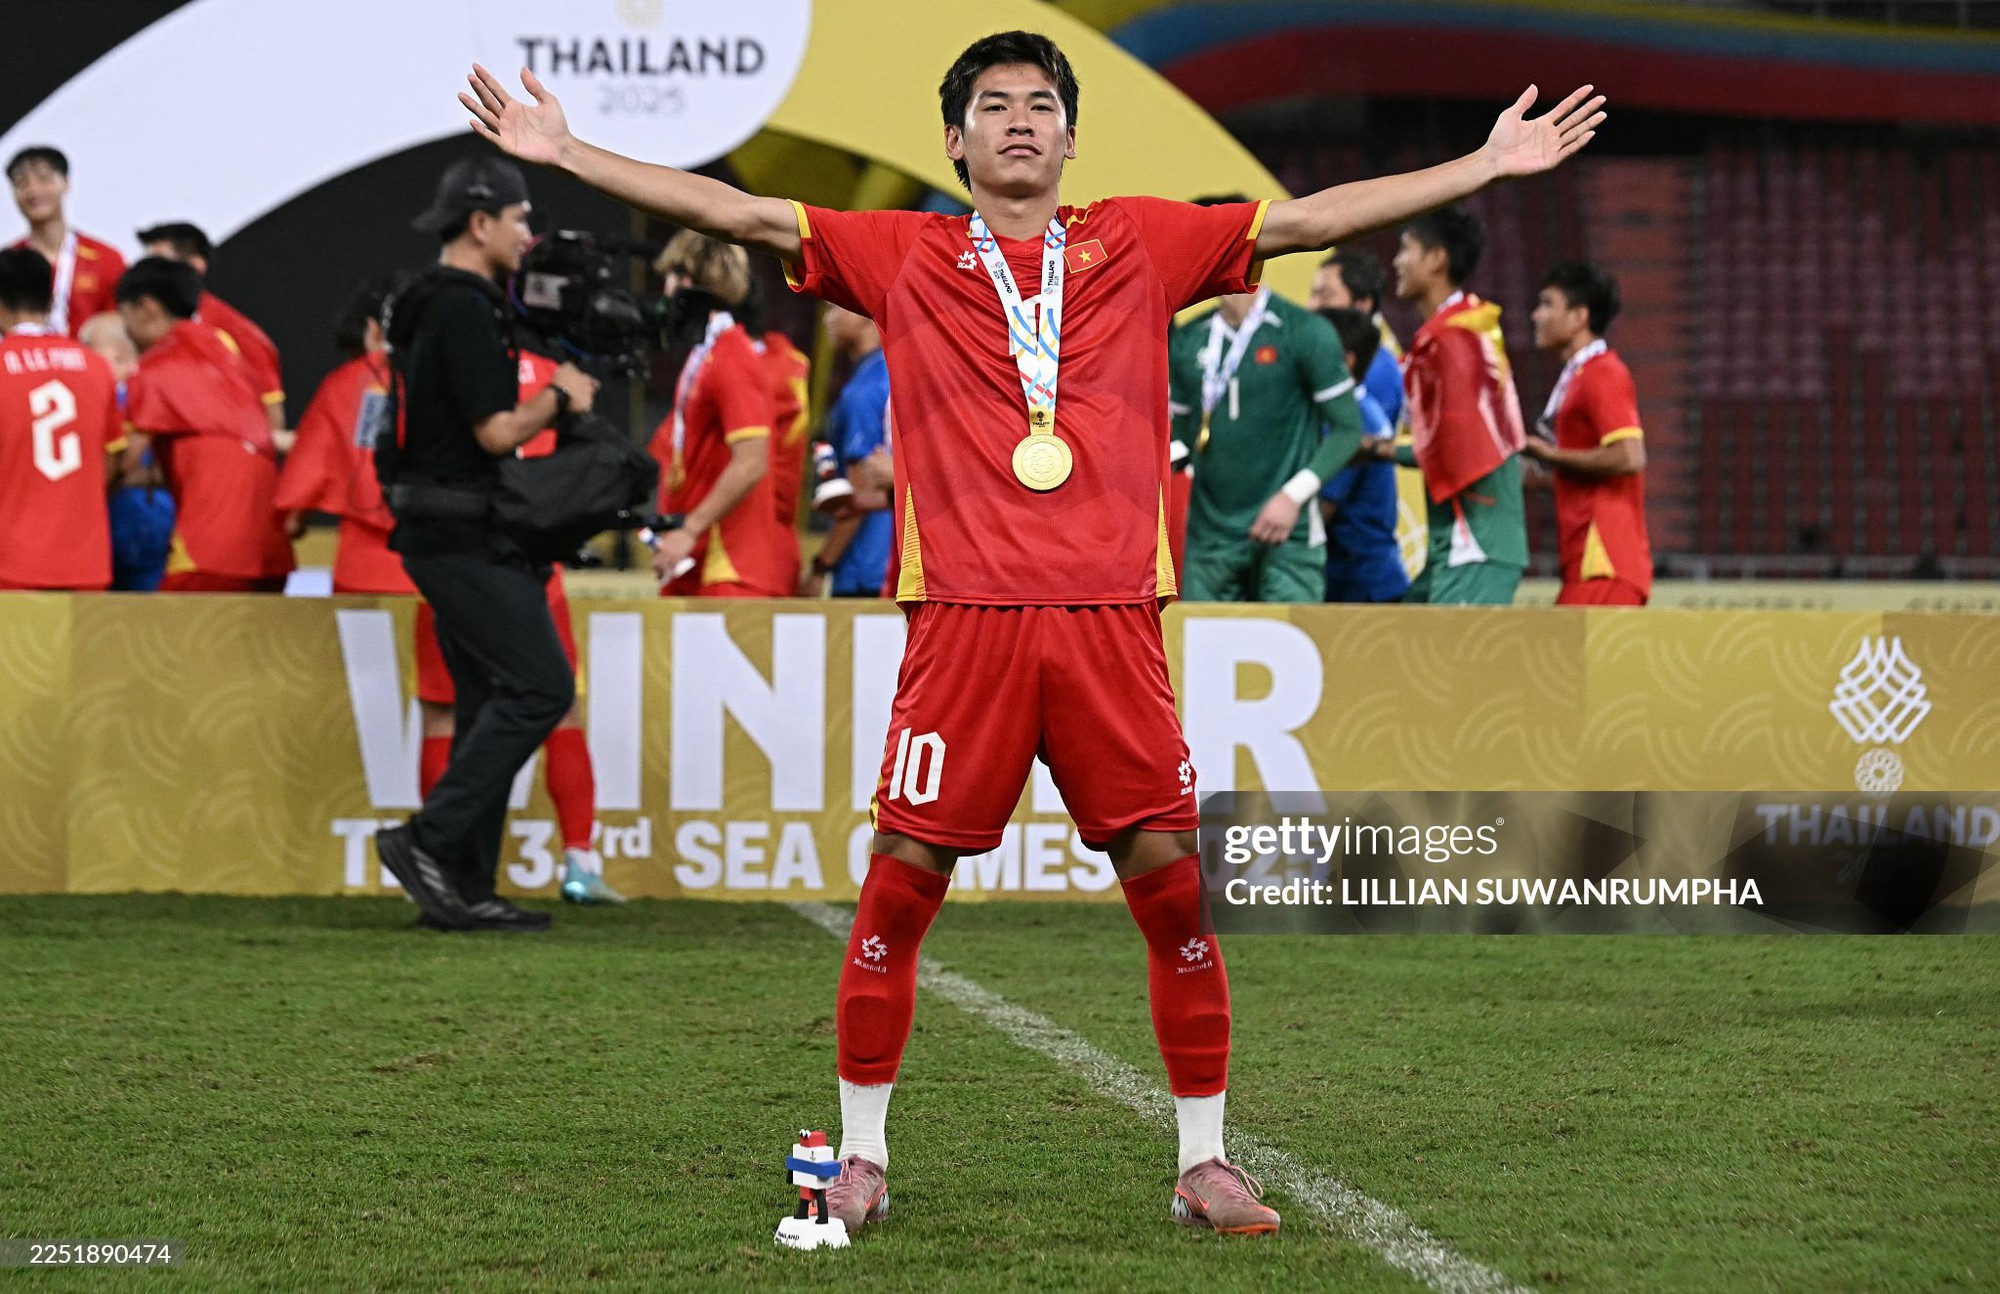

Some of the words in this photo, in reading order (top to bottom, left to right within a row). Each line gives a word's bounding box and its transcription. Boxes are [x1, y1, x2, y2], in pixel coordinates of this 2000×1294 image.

[515, 37, 766, 75] THAILAND
[598, 84, 686, 115] 2025
[29, 379, 82, 482] 2
[888, 727, 947, 806] 10
[1754, 803, 2000, 848] THAILAND
[674, 821, 825, 890] SEA
